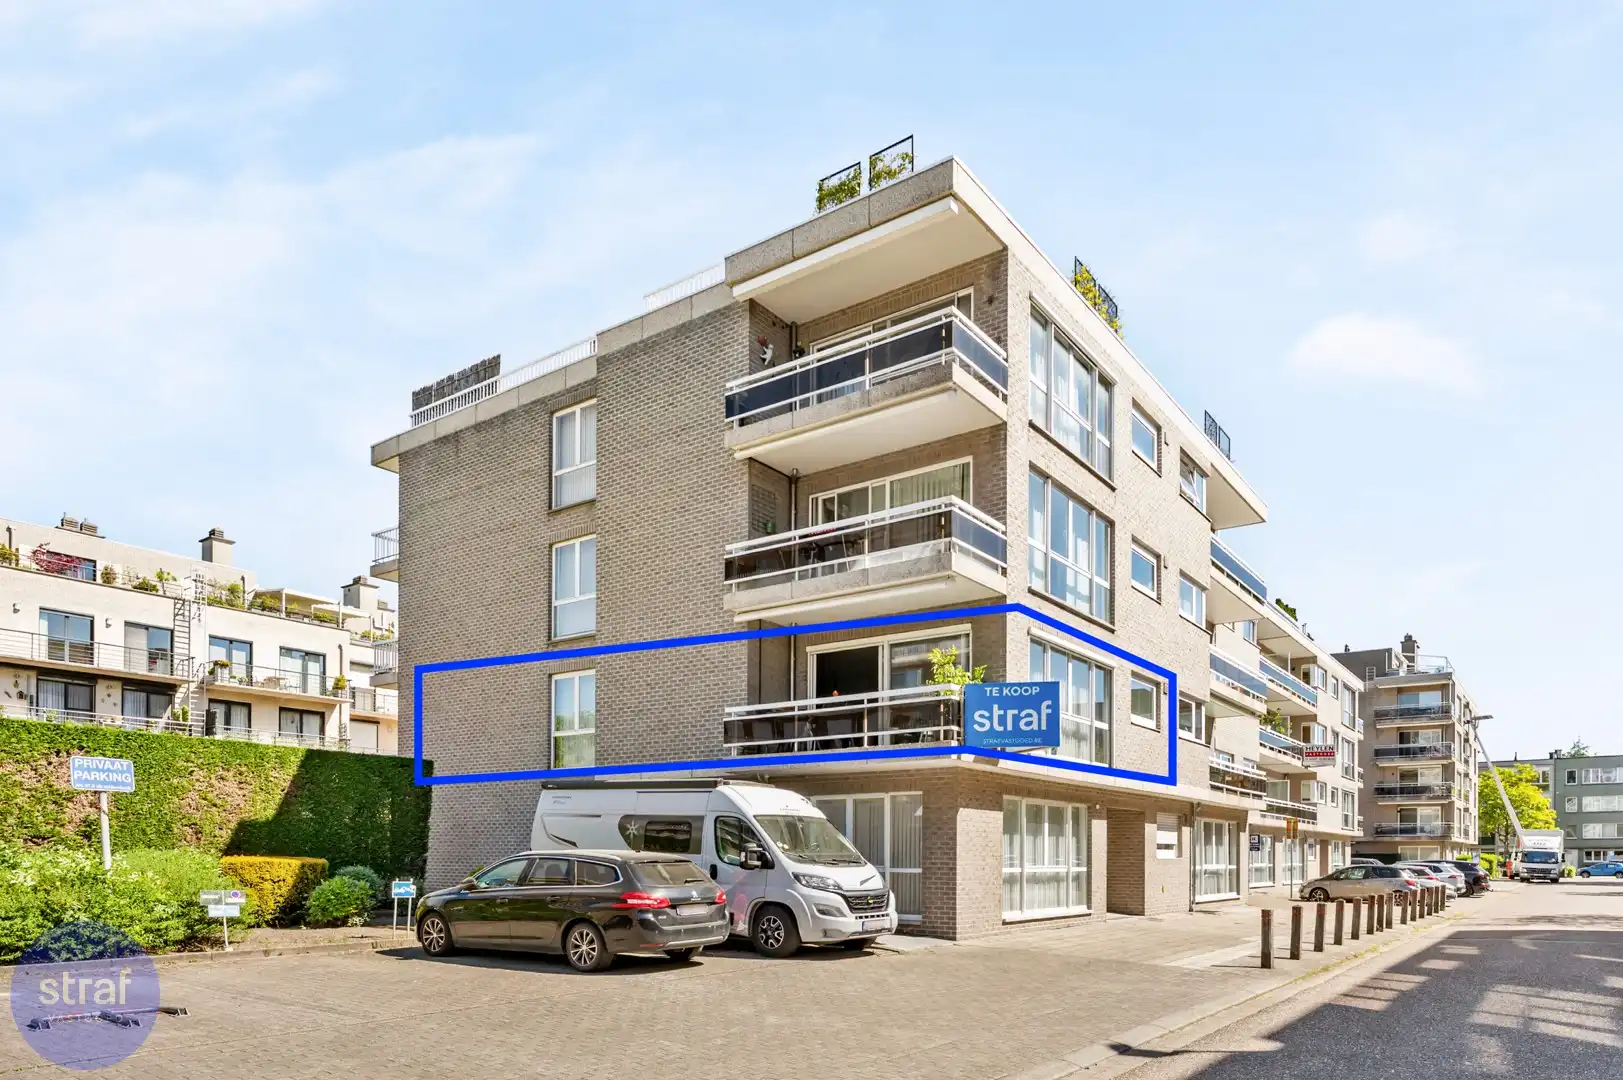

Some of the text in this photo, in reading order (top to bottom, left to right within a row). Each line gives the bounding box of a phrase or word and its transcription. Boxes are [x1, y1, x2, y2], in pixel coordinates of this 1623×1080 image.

[985, 686, 1040, 696] TE KOOP
[973, 700, 1052, 732] straf
[75, 758, 129, 770] PRIVAAT
[74, 770, 131, 782] PARKING
